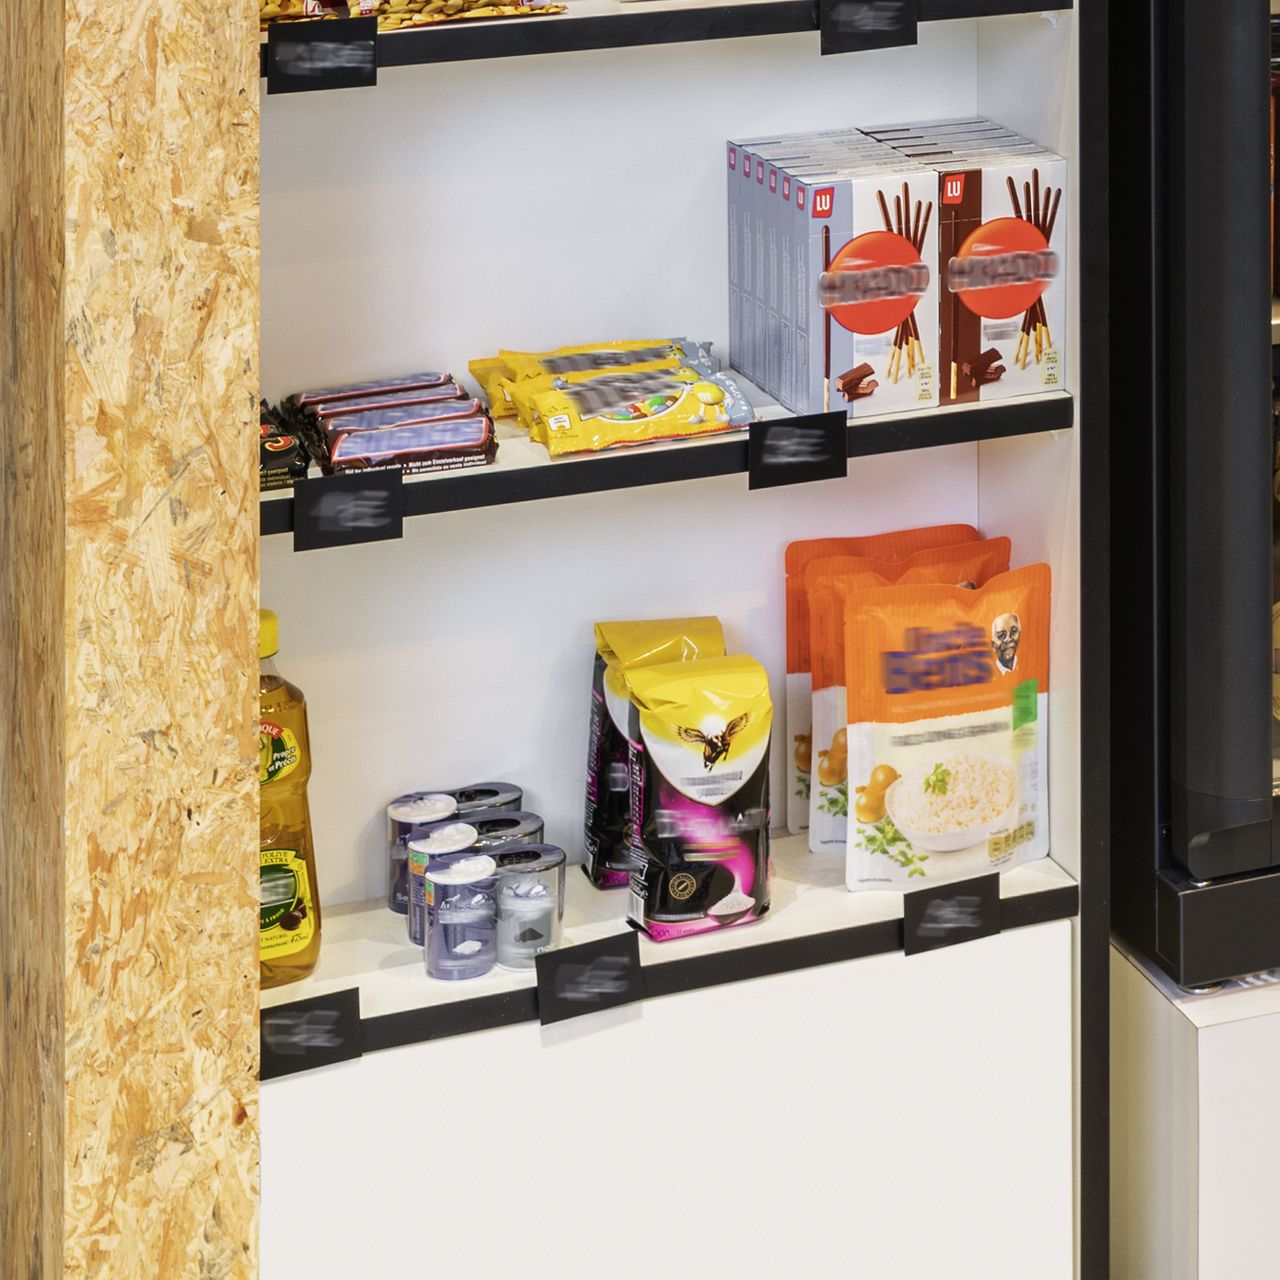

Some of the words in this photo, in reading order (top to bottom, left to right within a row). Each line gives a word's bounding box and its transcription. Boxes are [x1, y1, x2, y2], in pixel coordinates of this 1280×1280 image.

[947, 181, 961, 197] LU
[816, 195, 830, 211] LU
[396, 892, 408, 901] Se
